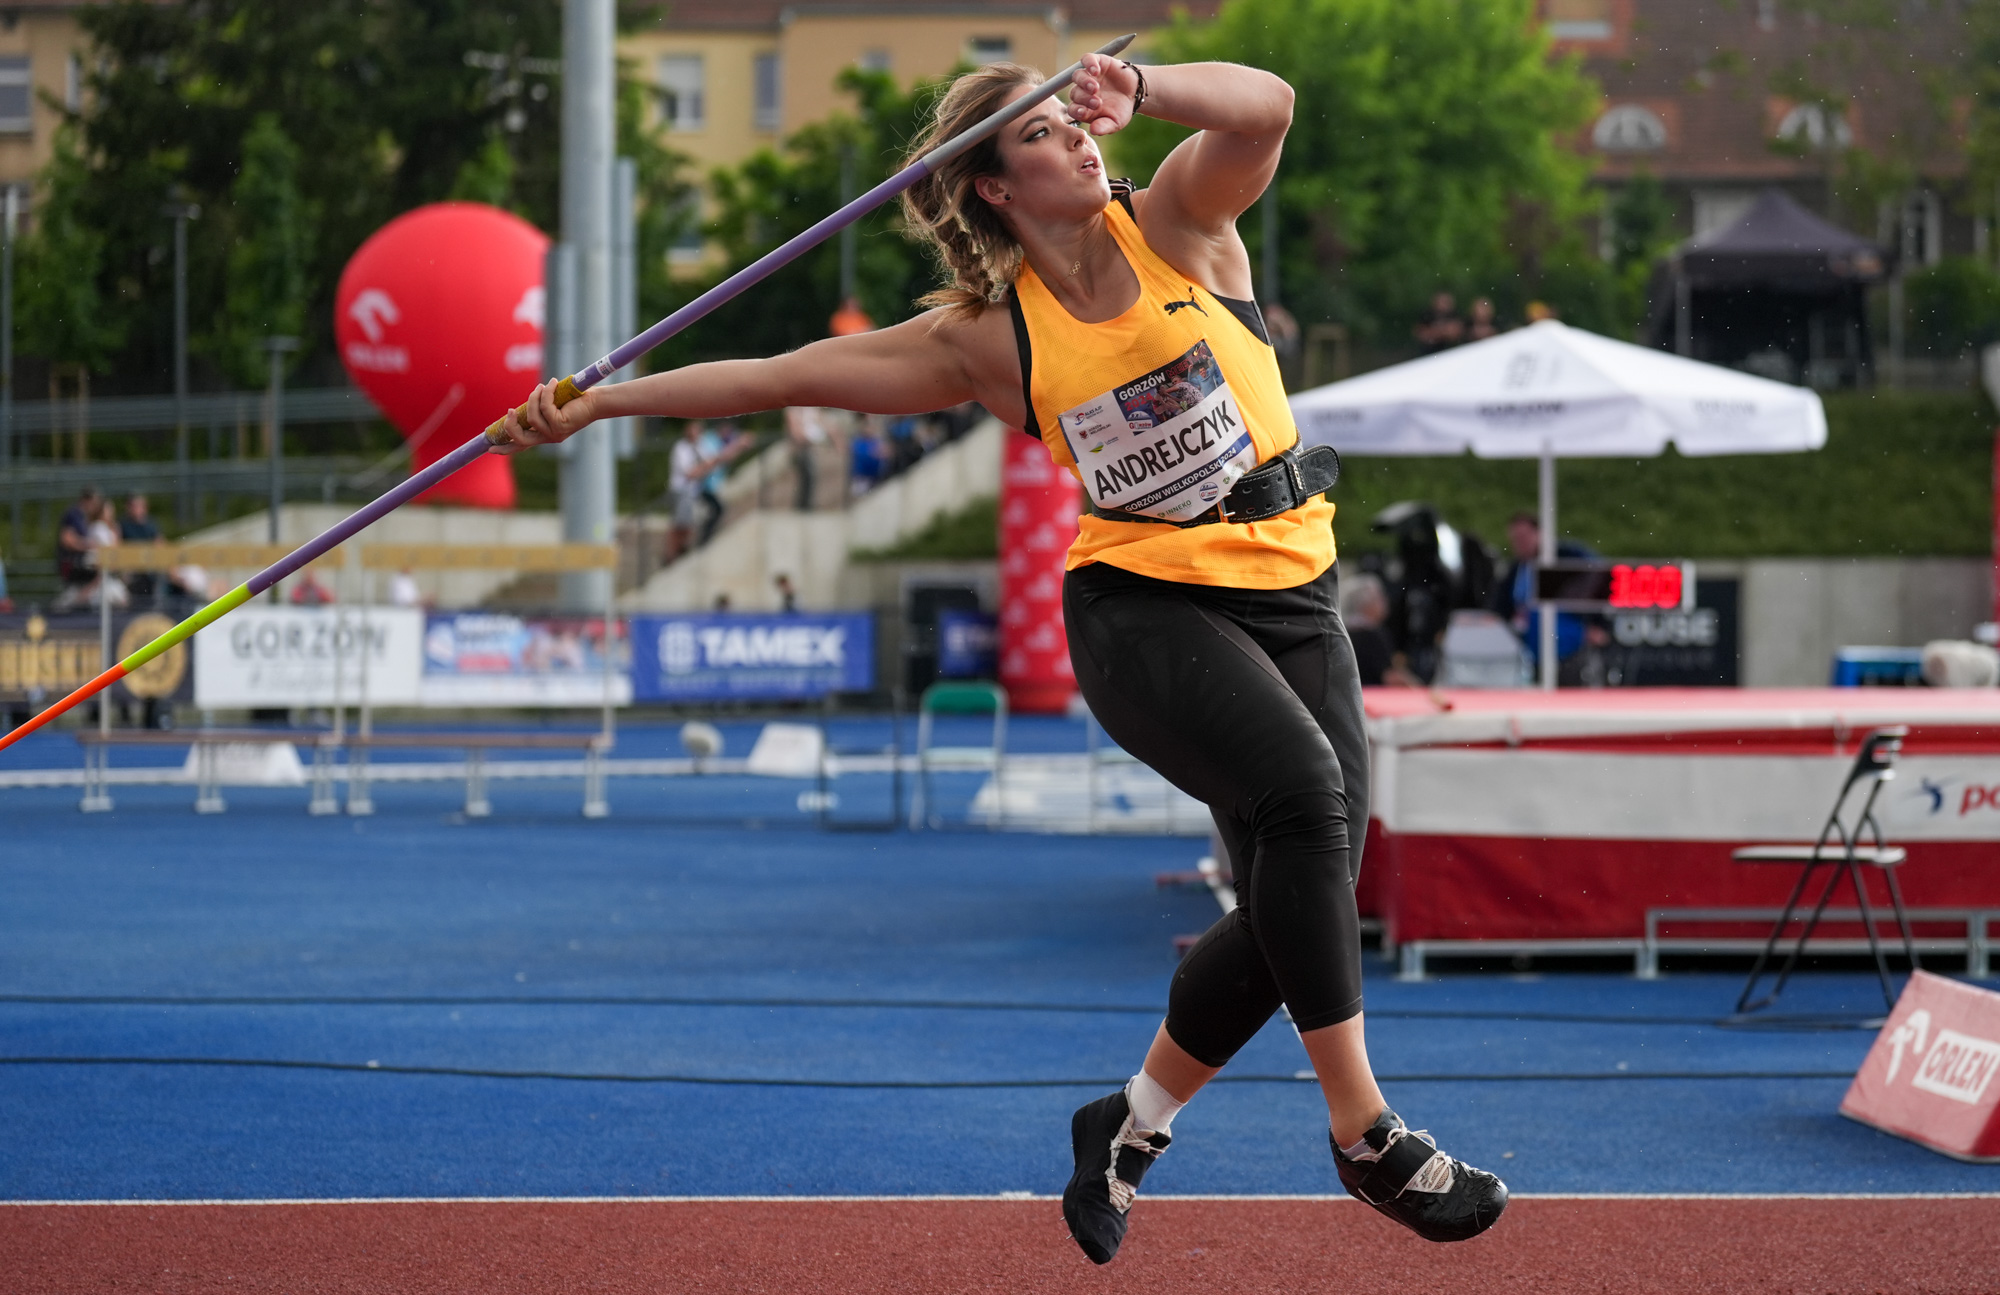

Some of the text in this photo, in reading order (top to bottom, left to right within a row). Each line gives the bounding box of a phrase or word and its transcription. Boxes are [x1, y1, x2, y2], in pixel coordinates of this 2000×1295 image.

[1118, 372, 1166, 401] GORZÓW
[1124, 391, 1155, 412] 2024
[1094, 399, 1237, 501] ANDREJCZYK
[1124, 491, 1163, 512] GORZÓW
[1163, 459, 1223, 496] WIELKOPOLSKI
[1220, 446, 1237, 464] 2024
[1165, 499, 1192, 516] INNEKO
[699, 624, 847, 669] TAMEX
[1923, 1040, 2000, 1094] ORLEN
